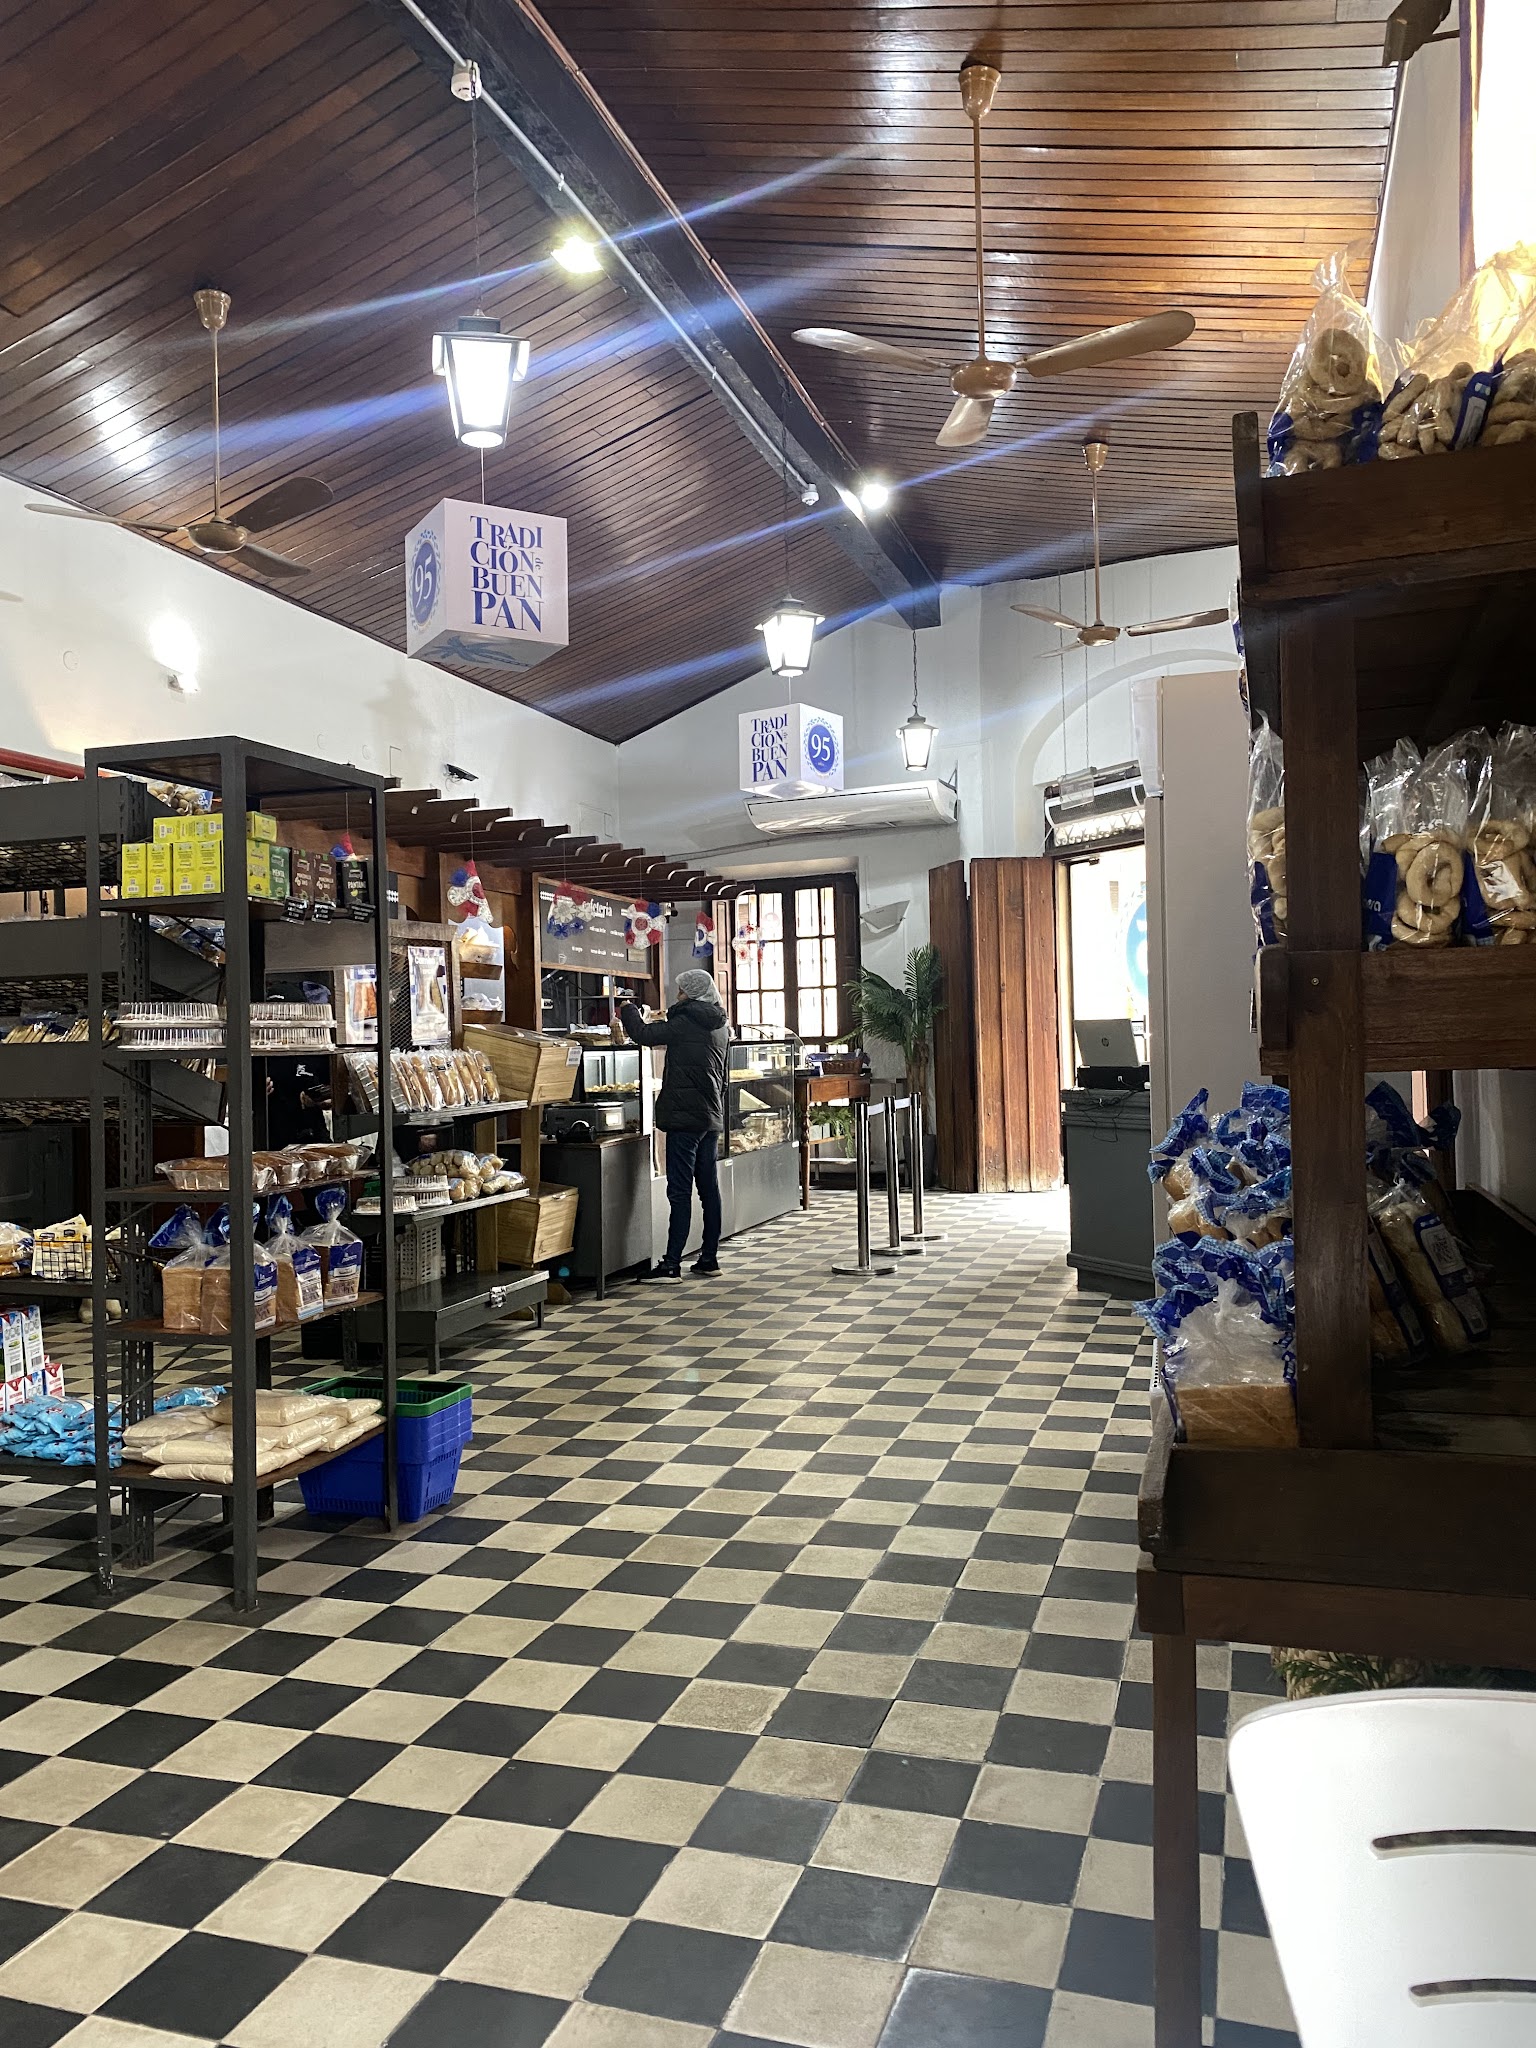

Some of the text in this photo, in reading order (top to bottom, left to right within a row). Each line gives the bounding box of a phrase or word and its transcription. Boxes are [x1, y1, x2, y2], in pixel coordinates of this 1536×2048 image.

[470, 515, 543, 549] TRADI
[470, 540, 544, 573] CIÓN de
[415, 553, 432, 608] 95
[471, 566, 543, 599] BUEN
[471, 589, 544, 633] PAN
[751, 713, 788, 733] TRADI
[751, 730, 783, 748] CIÓN
[752, 743, 788, 763] BUEN
[811, 733, 831, 761] 95
[752, 758, 788, 782] PAN
